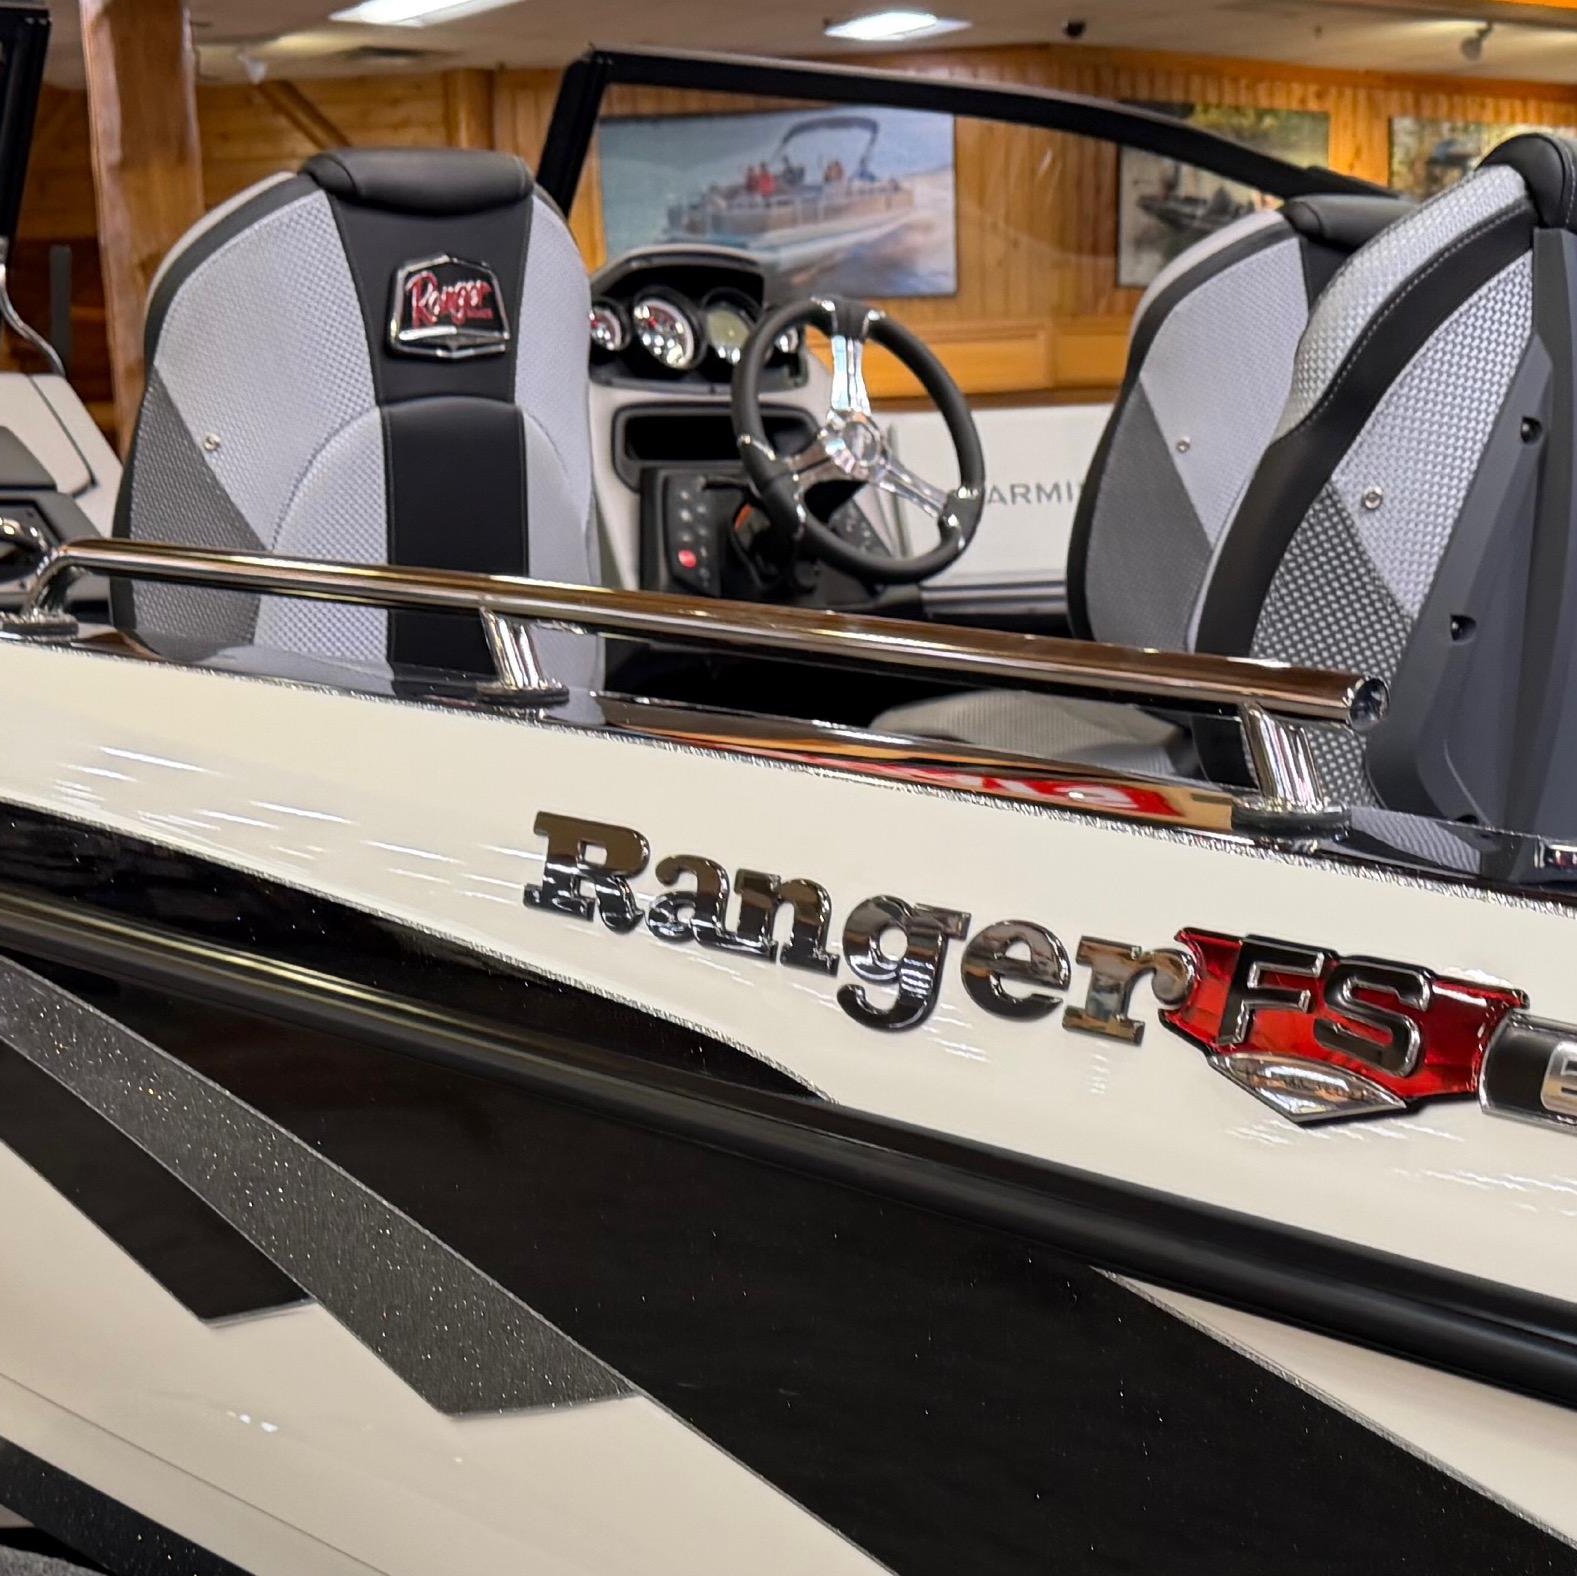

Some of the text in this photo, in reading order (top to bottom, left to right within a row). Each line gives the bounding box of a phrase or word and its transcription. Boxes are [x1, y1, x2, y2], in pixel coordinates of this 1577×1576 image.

[986, 480, 1084, 505] ARMI
[523, 810, 1204, 1046] Ranger
[1216, 933, 1431, 1078] FS
